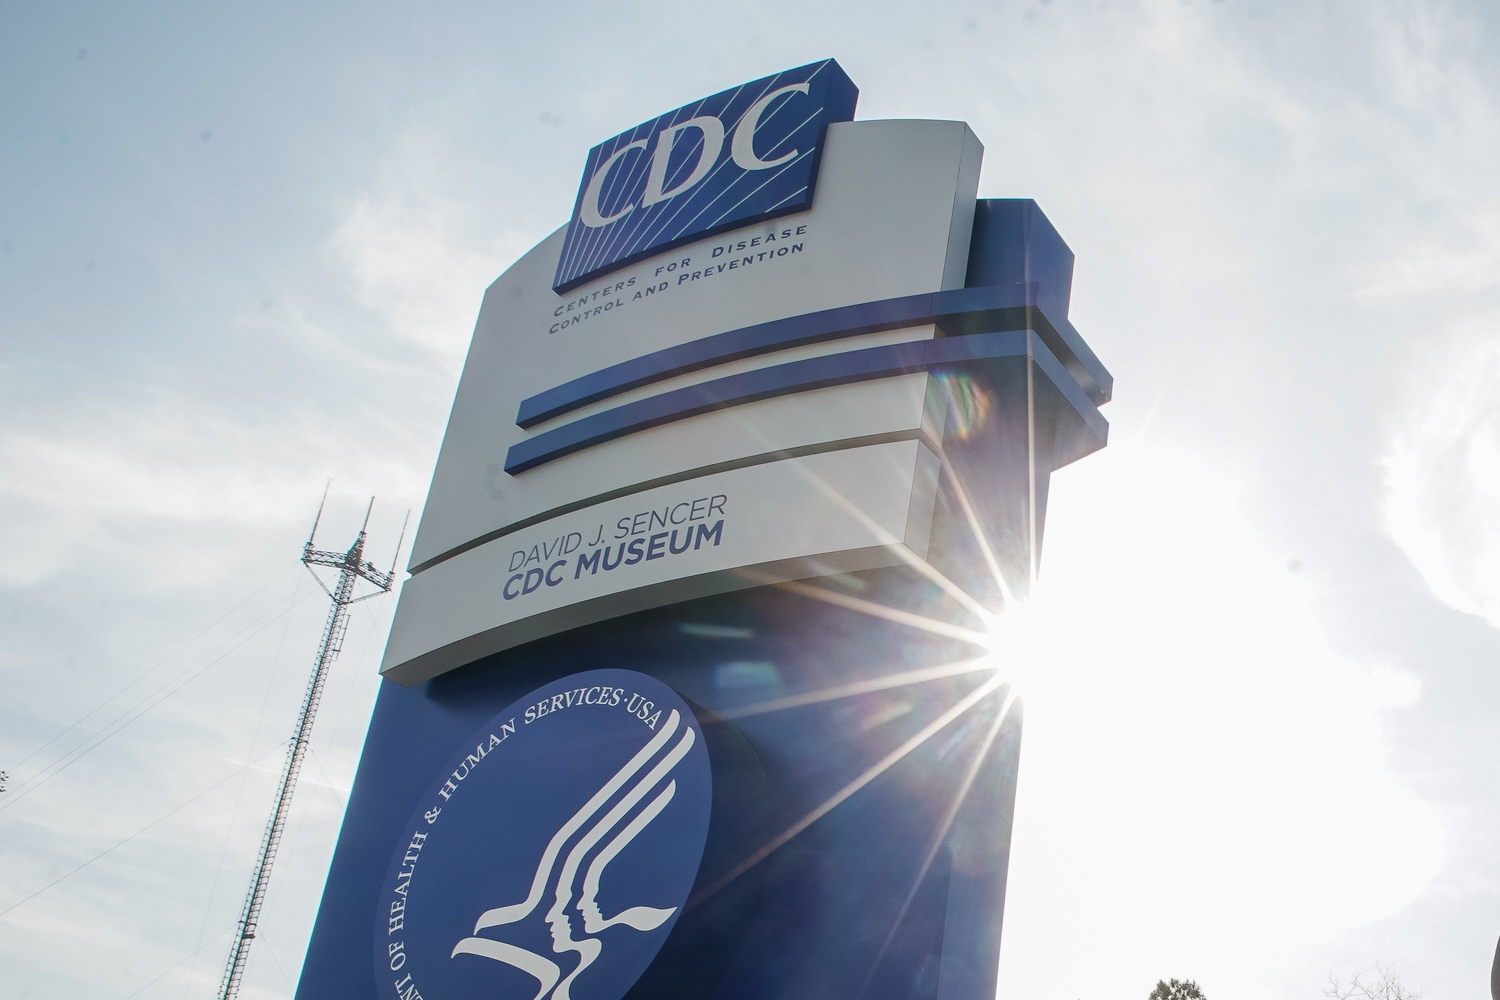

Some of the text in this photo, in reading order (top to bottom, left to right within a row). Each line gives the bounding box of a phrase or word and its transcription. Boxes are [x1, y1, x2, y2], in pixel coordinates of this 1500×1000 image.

[580, 82, 810, 228] CDC
[549, 243, 804, 335] CONTROL AND PREVENTION
[554, 225, 808, 317] CENTERS FOR DISEASE
[502, 519, 725, 601] CDC MUSEUM
[508, 494, 728, 573] DAVID J. SENCER
[437, 718, 517, 802] HUMAN
[424, 805, 442, 825] &
[388, 830, 428, 935] HEALTH
[388, 941, 406, 971] OF
